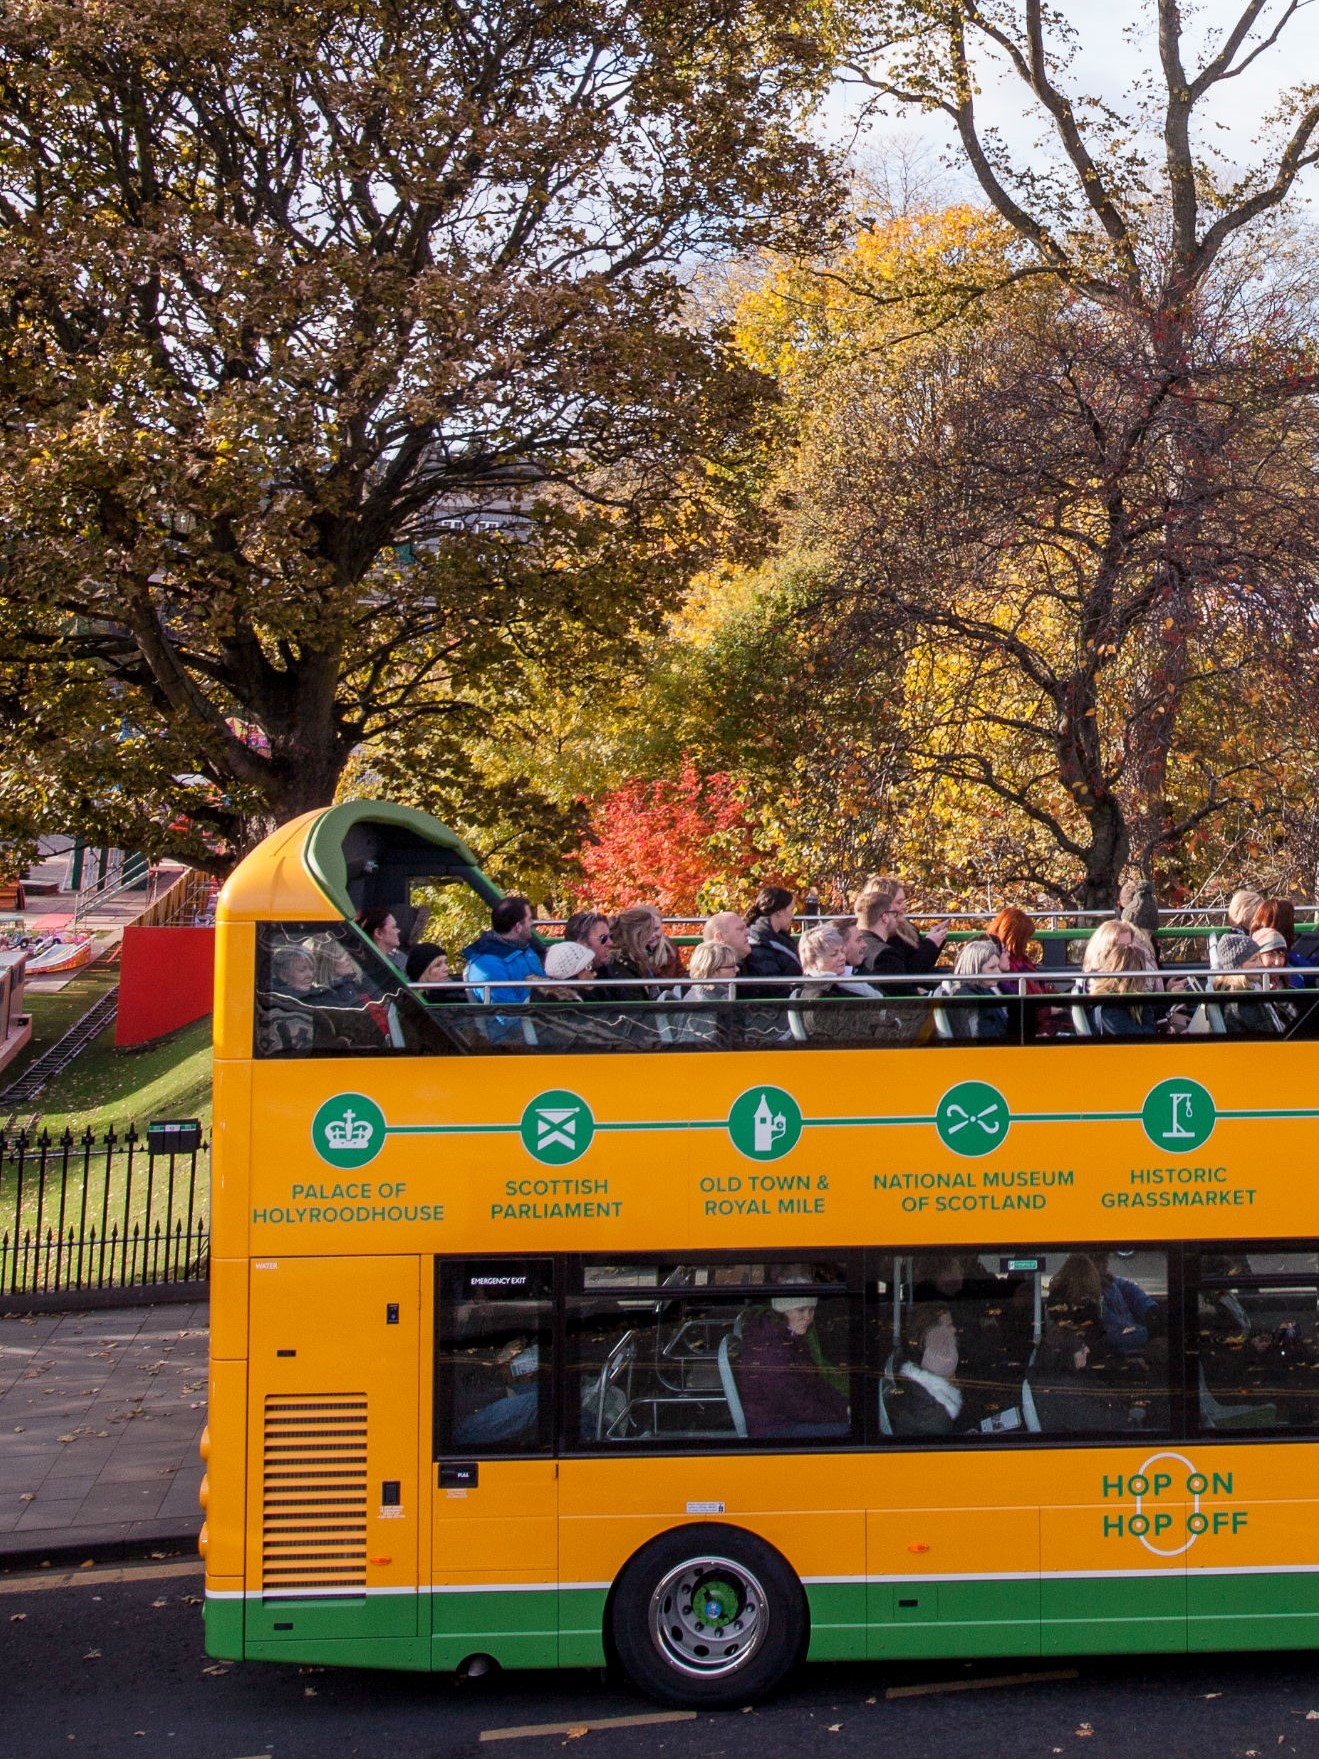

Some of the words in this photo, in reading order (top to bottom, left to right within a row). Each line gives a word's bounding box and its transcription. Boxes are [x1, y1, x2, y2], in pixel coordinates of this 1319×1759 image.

[699, 1177, 742, 1193] OLD
[748, 1176, 812, 1192] TOWN
[817, 1175, 830, 1191] &
[873, 1172, 977, 1189] NATIONAL
[981, 1170, 1074, 1187] MUSEUM
[1130, 1167, 1227, 1185] HISTORIC
[292, 1183, 371, 1200] PALACE
[378, 1182, 406, 1199] OF
[505, 1178, 608, 1197] SCOTTISH
[704, 1198, 772, 1216] ROYAL
[777, 1197, 825, 1214] MILE
[901, 1196, 929, 1213] OF
[935, 1194, 1047, 1212] SCOTLAND
[1100, 1189, 1257, 1209] GRASSMARKET
[253, 1205, 444, 1224] HOLYROODHOUSE
[490, 1201, 623, 1220] PARLIAMENT
[255, 1262, 279, 1270] WATER
[470, 1277, 510, 1285] EMERGENCY
[511, 1276, 527, 1284] EXIT
[1102, 1473, 1172, 1497] HOP
[1186, 1472, 1233, 1495] ON
[1103, 1513, 1173, 1537] HOP
[1186, 1511, 1249, 1535] OFF
